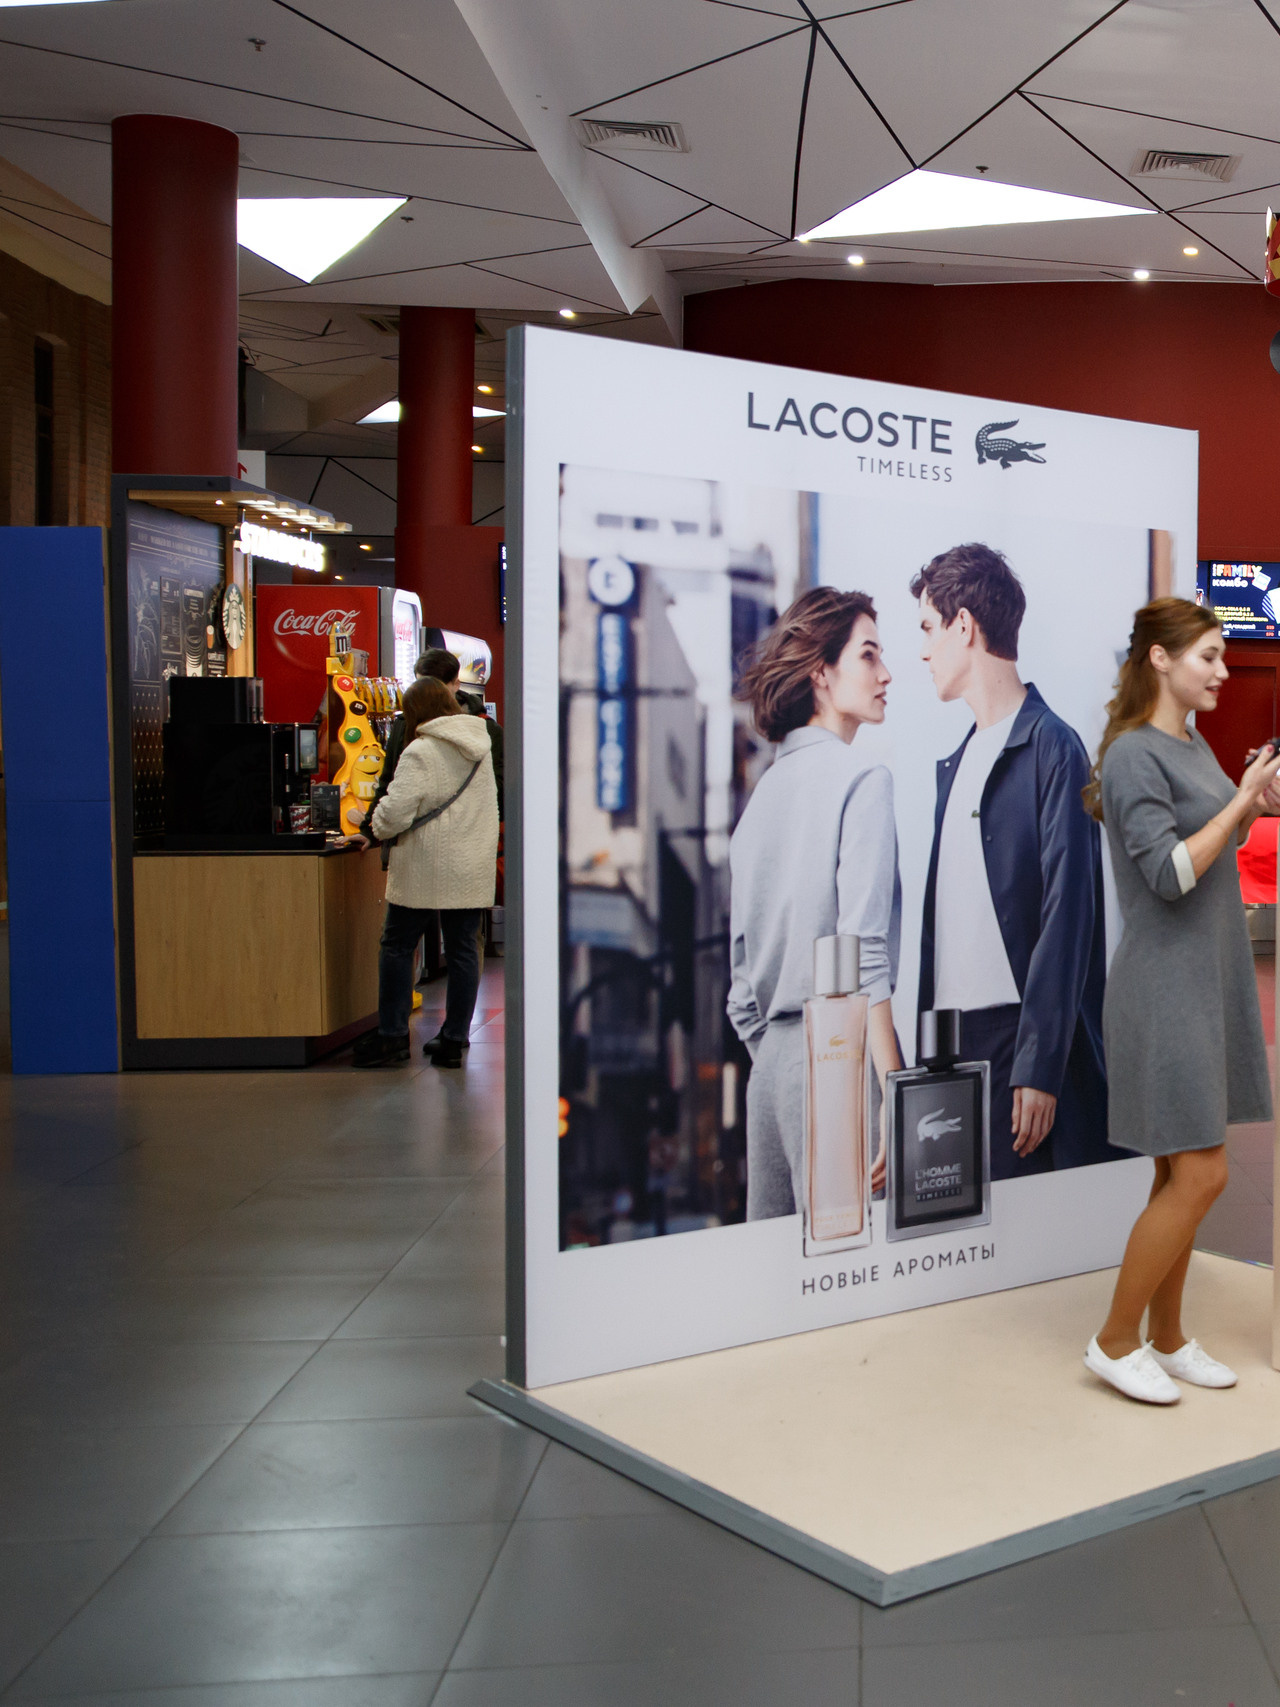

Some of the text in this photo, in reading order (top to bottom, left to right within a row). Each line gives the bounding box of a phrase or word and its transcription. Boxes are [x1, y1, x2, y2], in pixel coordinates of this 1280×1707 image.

[747, 391, 953, 455] LACOSTE
[857, 456, 953, 483] TIMELESS
[1216, 564, 1262, 578] FAMILY
[914, 1163, 962, 1181] L'HOMME
[914, 1174, 963, 1193] LACOSTE
[802, 1242, 996, 1295] НОВЫЕ АРОМАТЫ
